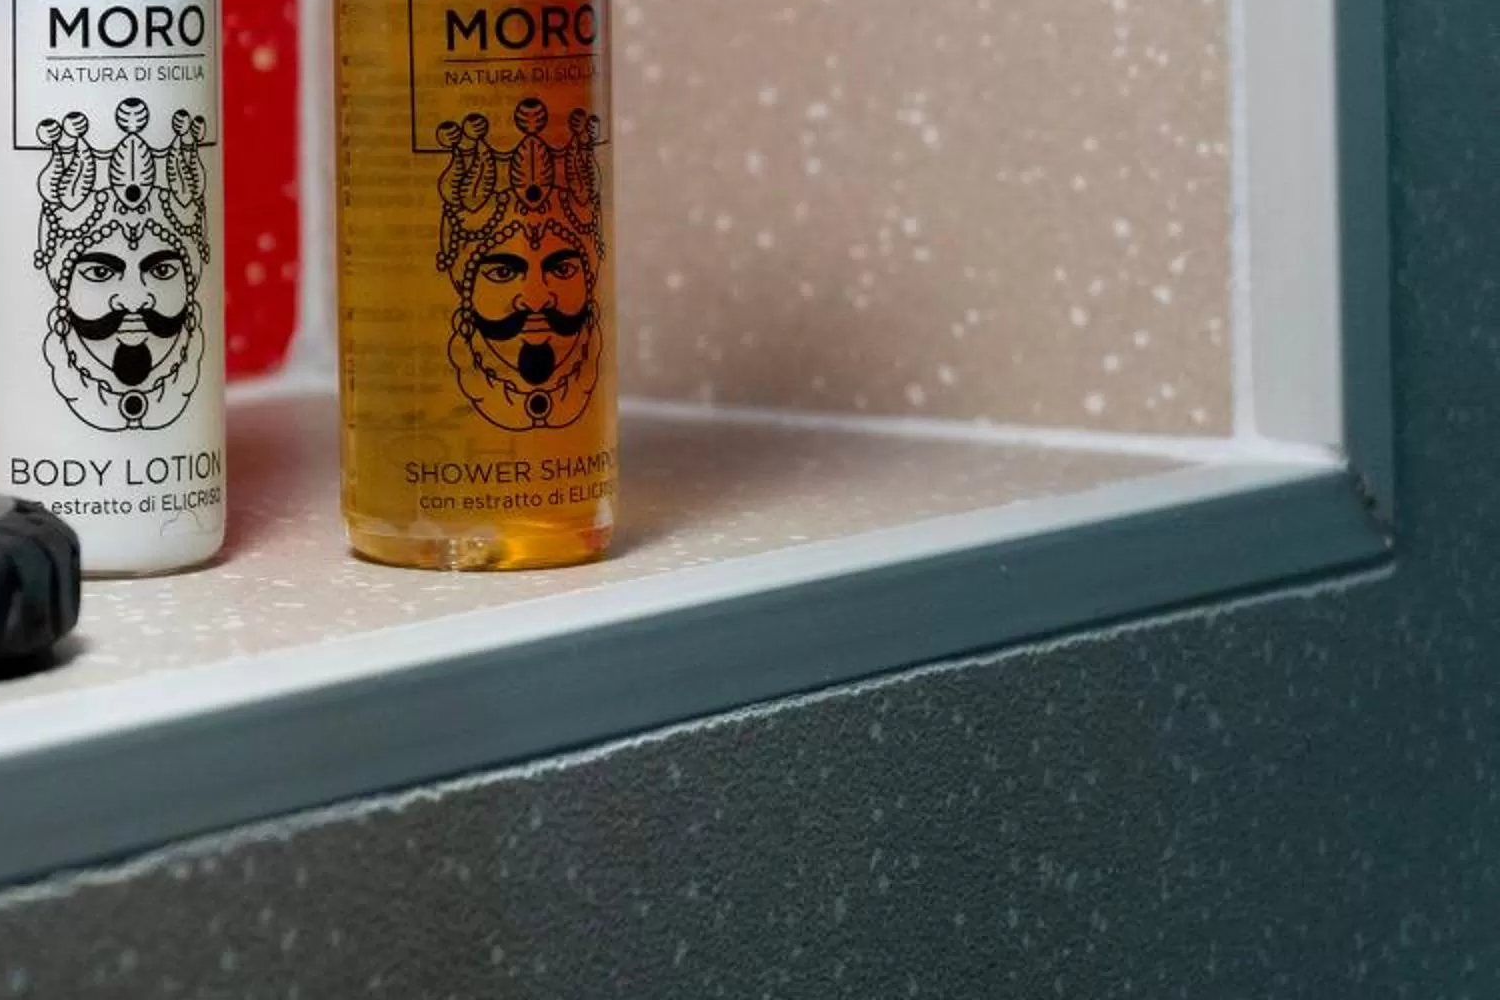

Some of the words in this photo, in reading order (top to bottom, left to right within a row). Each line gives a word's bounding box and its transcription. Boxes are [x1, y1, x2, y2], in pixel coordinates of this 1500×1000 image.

[49, 4, 205, 48] MORO
[446, 4, 597, 51] MORO
[46, 66, 129, 82] NATURA
[135, 66, 151, 80] DI
[157, 64, 205, 81] SICILIA
[445, 68, 526, 85] NATURA
[532, 67, 550, 80] DI
[11, 457, 113, 486] BODY
[126, 449, 221, 485] LOTION
[405, 462, 531, 485] SHOWER
[541, 451, 613, 481] SHAMP
[51, 496, 132, 515] estratto
[139, 495, 155, 513] di
[420, 494, 455, 509] con
[463, 491, 542, 510] estratto
[548, 487, 564, 504] di
[569, 479, 613, 504] ELIC
